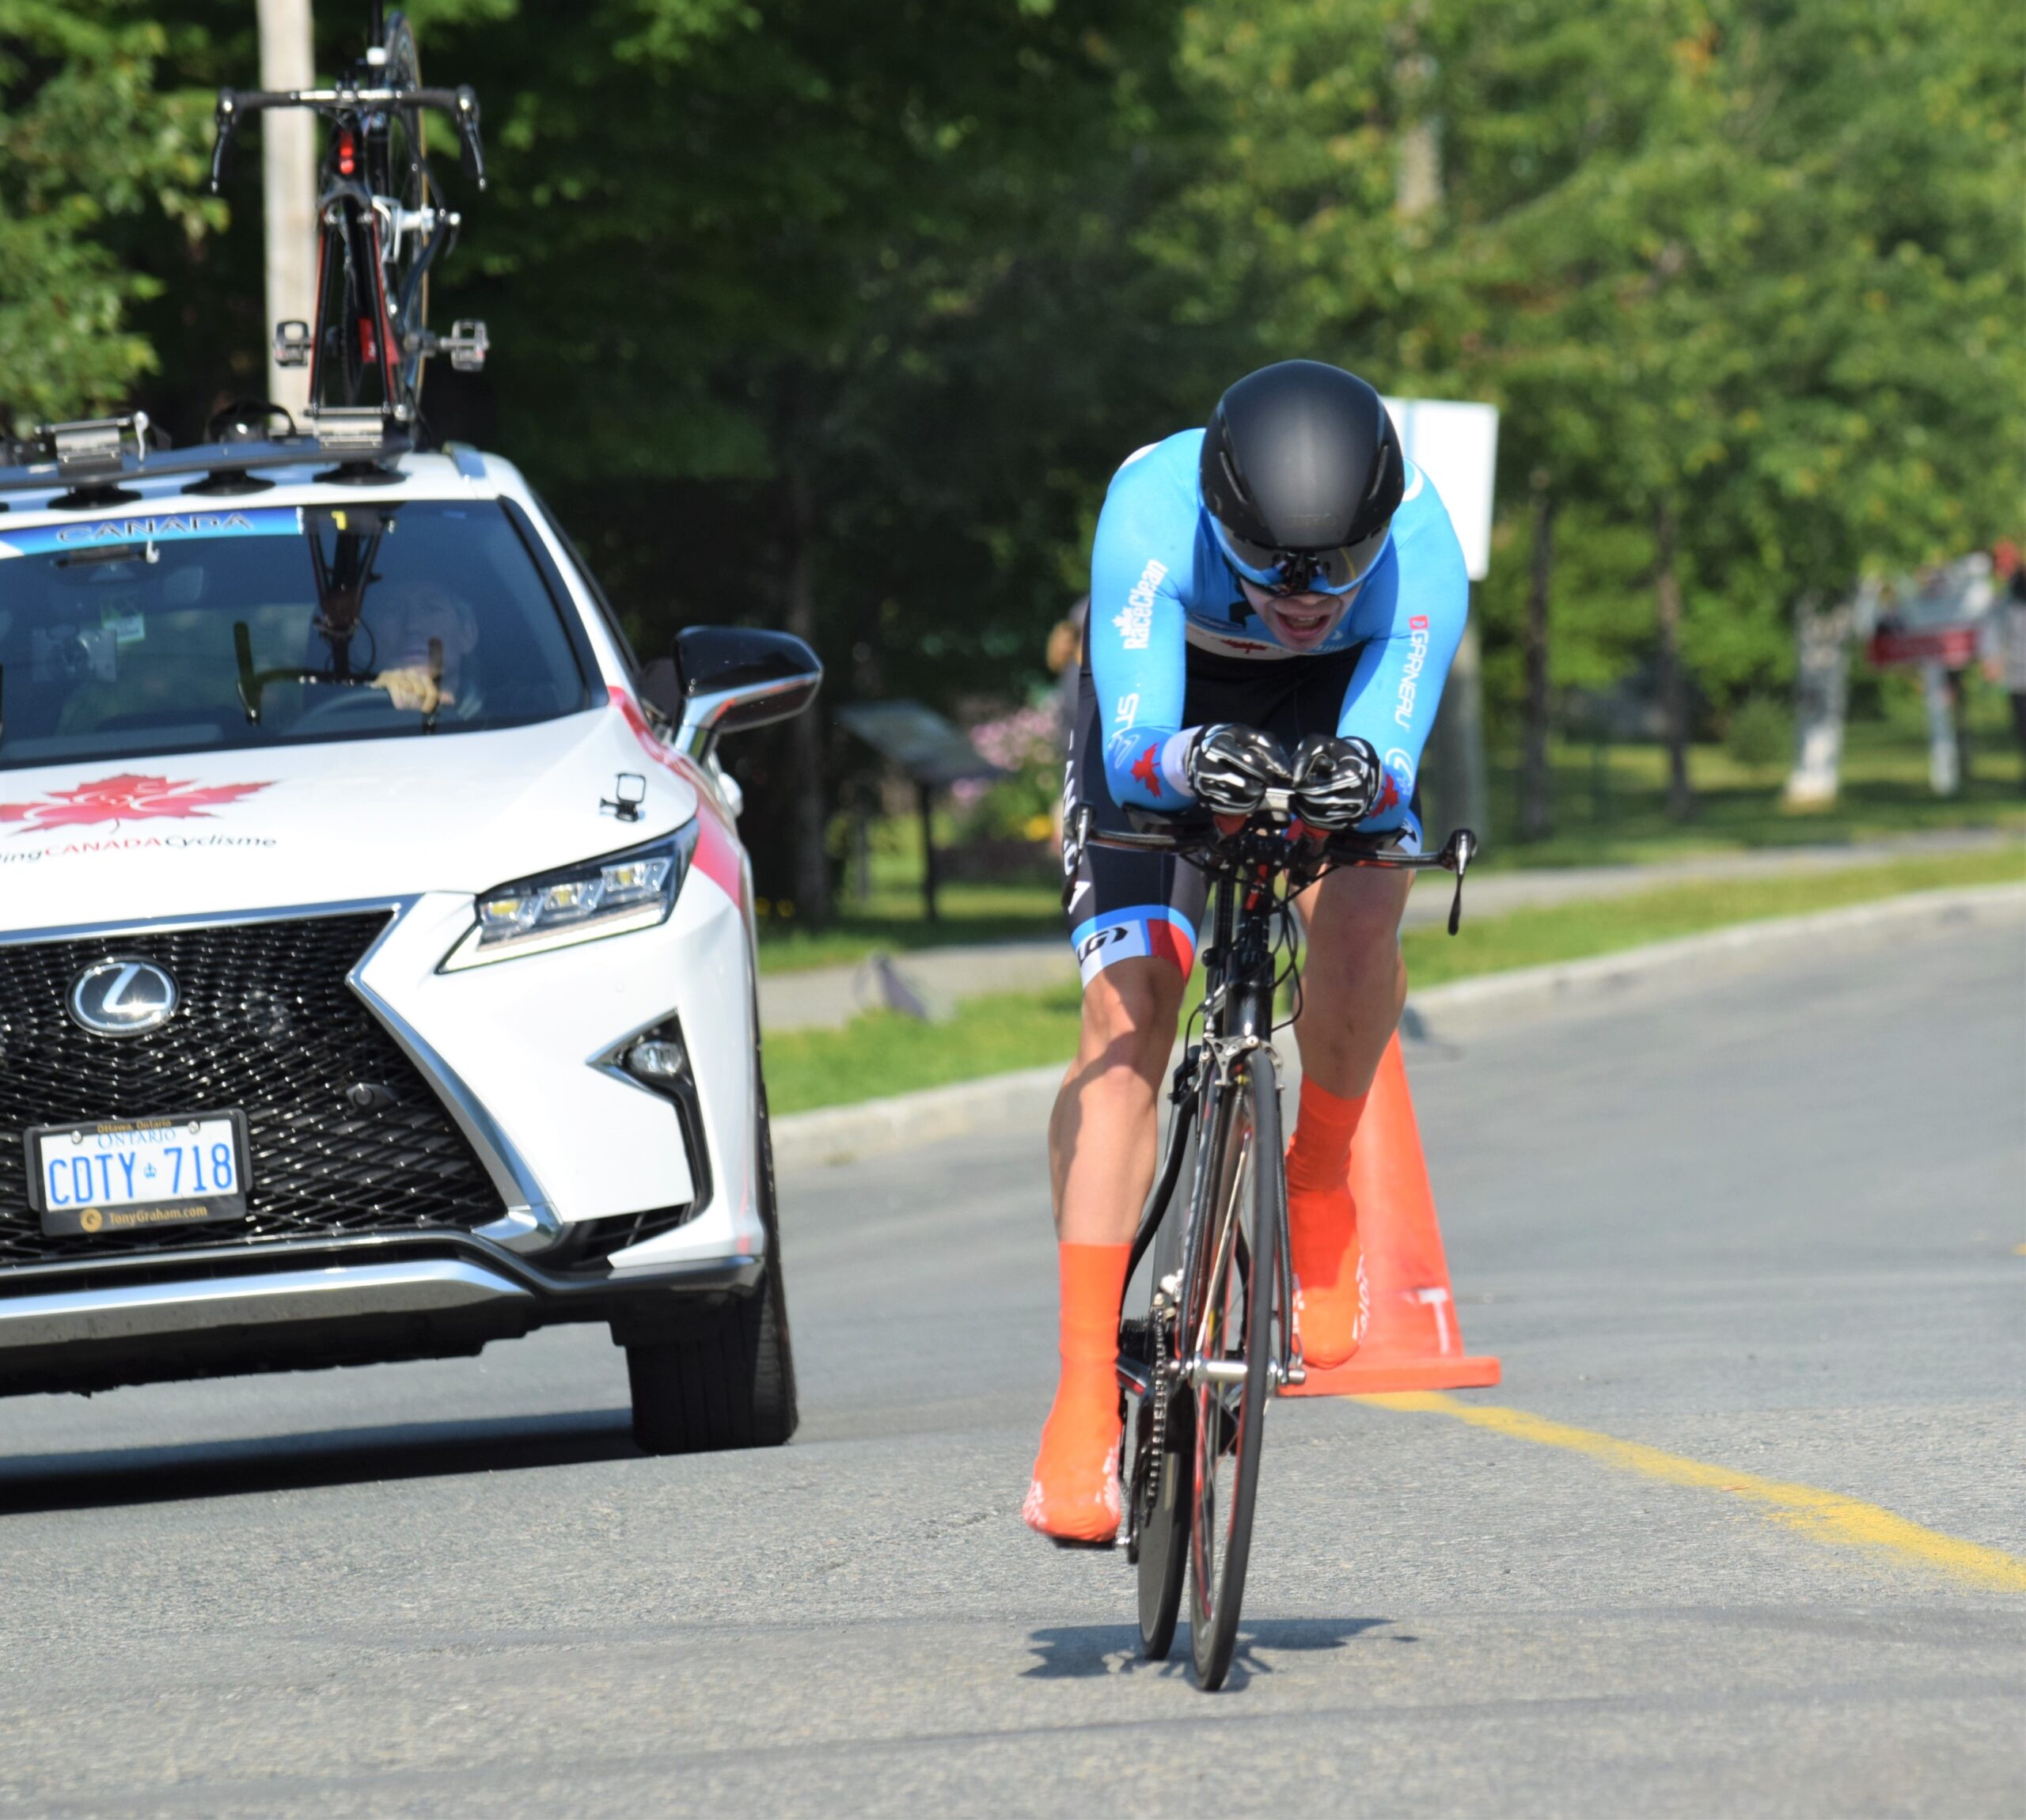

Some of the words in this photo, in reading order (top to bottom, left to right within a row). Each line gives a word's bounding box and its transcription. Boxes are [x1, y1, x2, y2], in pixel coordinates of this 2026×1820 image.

[57, 513, 252, 543] CANADA
[1123, 559, 1168, 649] RaceClean
[1395, 631, 1429, 730] GARNEAU
[49, 1151, 135, 1205] CDTY
[164, 1143, 233, 1194] 718
[109, 1206, 207, 1226] TonyGraham.com
